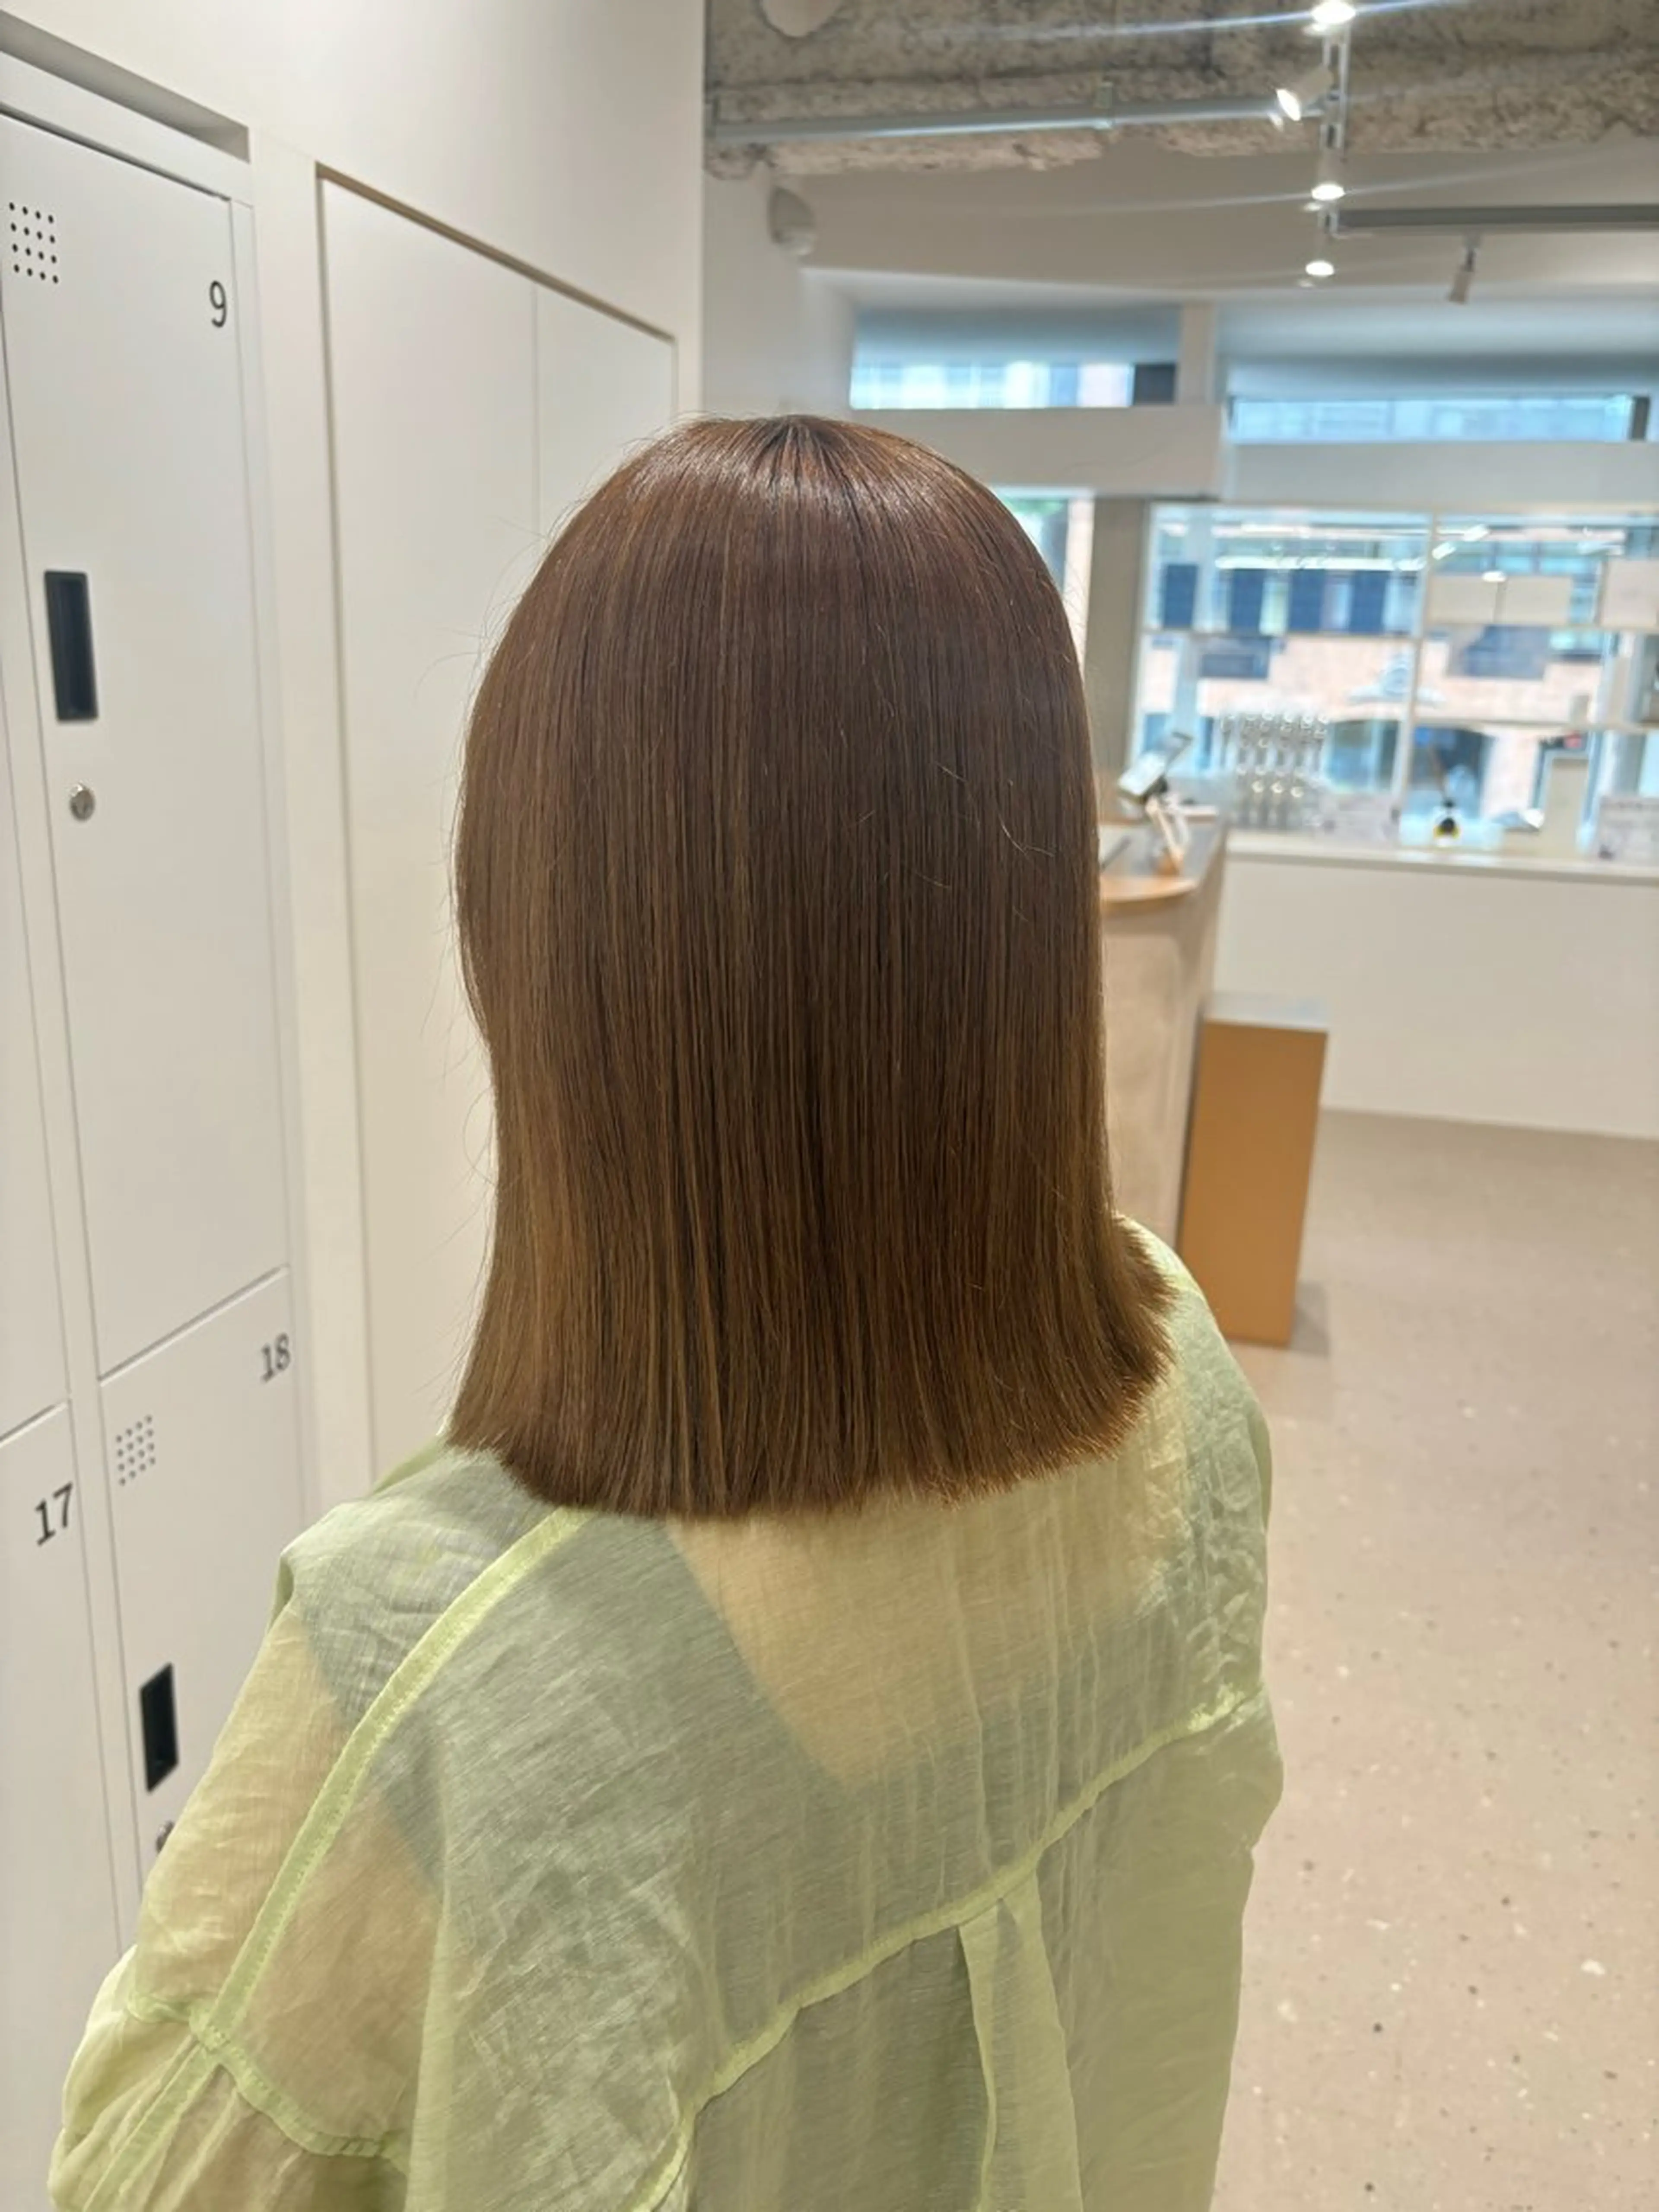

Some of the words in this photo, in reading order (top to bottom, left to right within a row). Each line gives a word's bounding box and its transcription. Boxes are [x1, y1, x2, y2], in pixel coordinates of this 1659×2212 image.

[209, 280, 227, 328] 9
[261, 1333, 290, 1382] 18
[35, 1481, 73, 1546] 17
